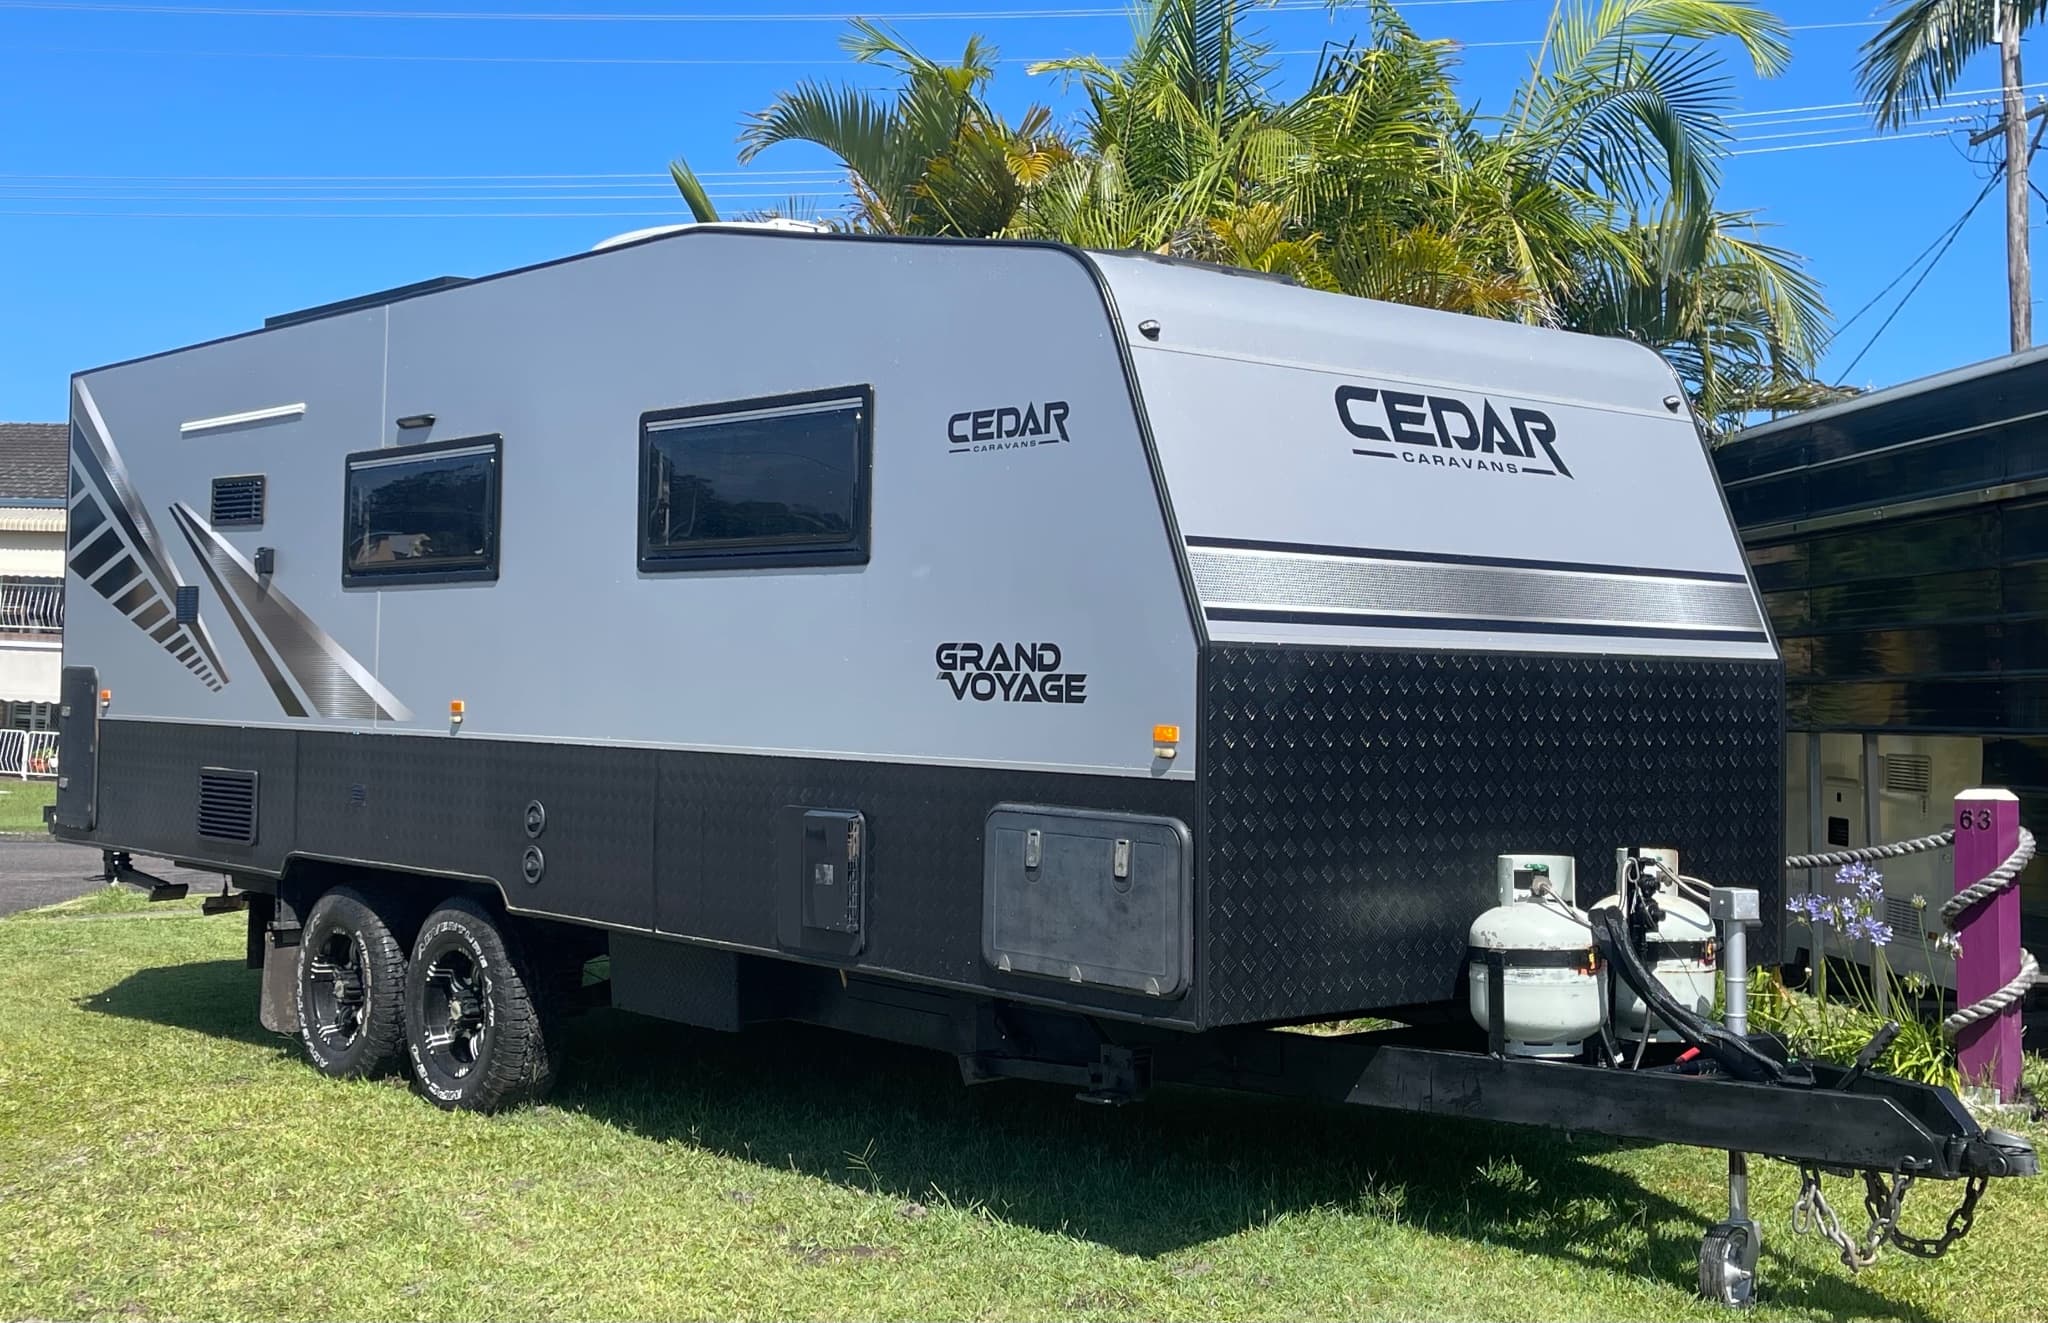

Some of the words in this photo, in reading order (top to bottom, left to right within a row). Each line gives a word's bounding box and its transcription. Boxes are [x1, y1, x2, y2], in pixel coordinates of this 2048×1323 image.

[948, 401, 1070, 443] CEDAR
[1335, 384, 1574, 480] CEDAR
[973, 440, 1037, 453] CARAVANS
[1402, 451, 1518, 474] CARAVANS
[936, 642, 1061, 672] GRAND
[937, 672, 1088, 704] VOYAGE
[1960, 808, 1991, 831] 63
